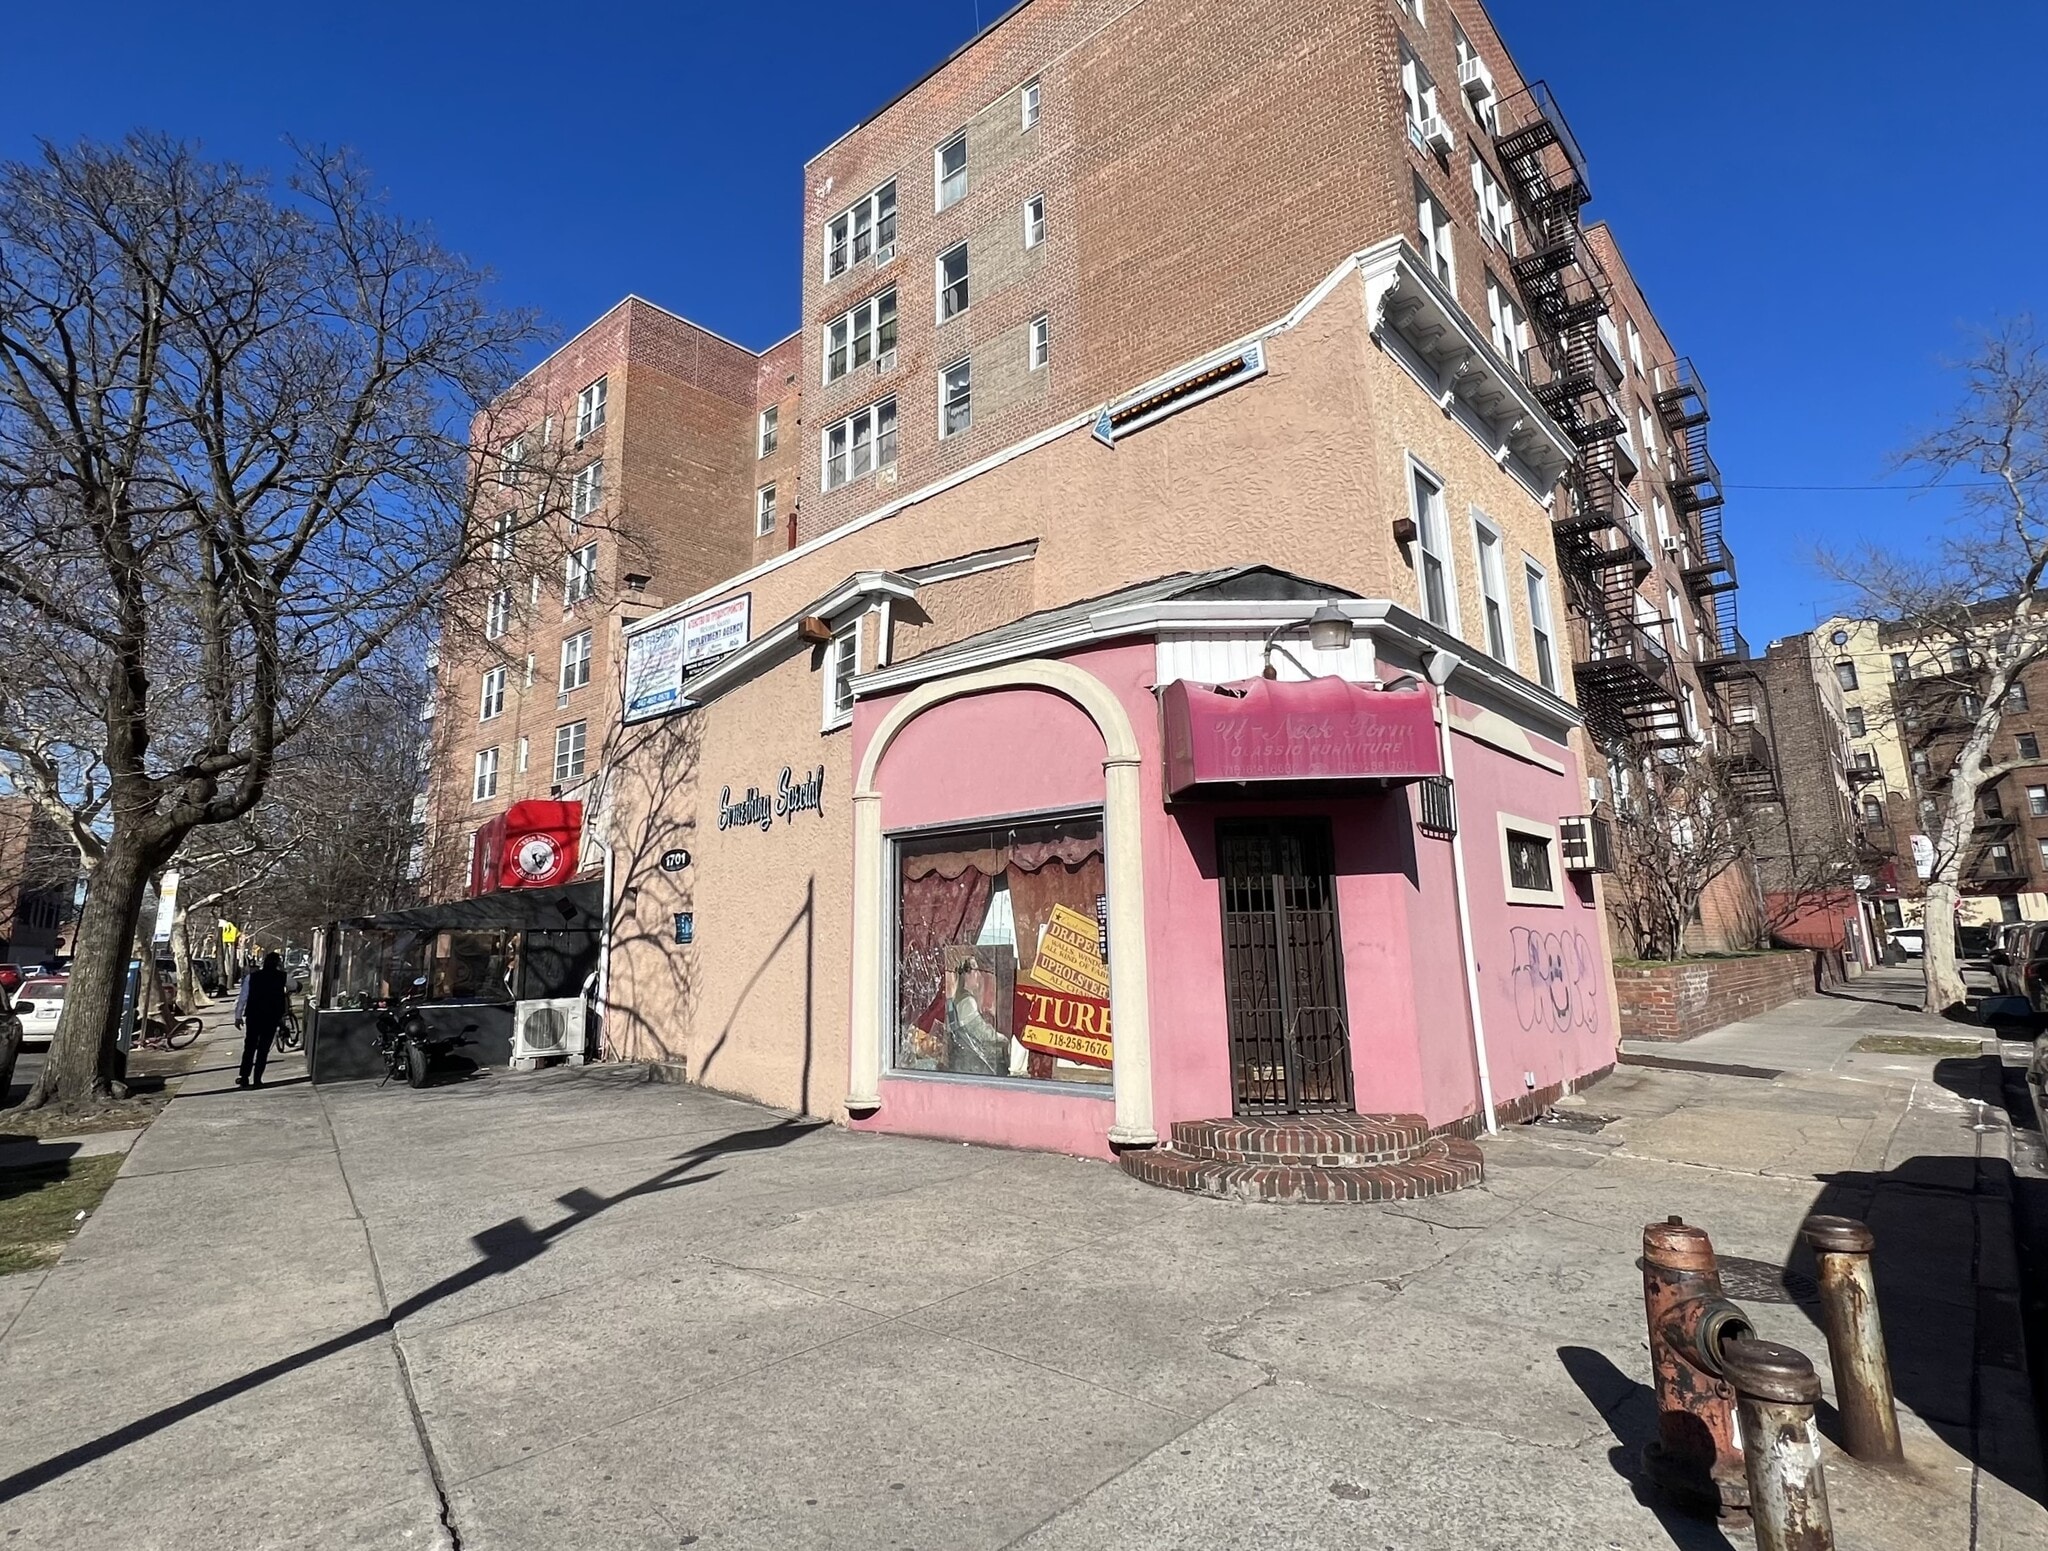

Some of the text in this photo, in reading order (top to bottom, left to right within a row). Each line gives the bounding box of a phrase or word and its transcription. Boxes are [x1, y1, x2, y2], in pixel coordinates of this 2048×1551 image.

[718, 764, 824, 832] Something Special
[665, 852, 686, 867] 1701
[1045, 944, 1057, 955] ALL
[1059, 950, 1077, 964] KIND
[1079, 960, 1088, 970] OF
[1040, 955, 1108, 999] UPHOLSTER
[1050, 975, 1064, 989] ALL
[1026, 993, 1112, 1037] TURE
[1048, 1032, 1108, 1057] 718-258-7676
